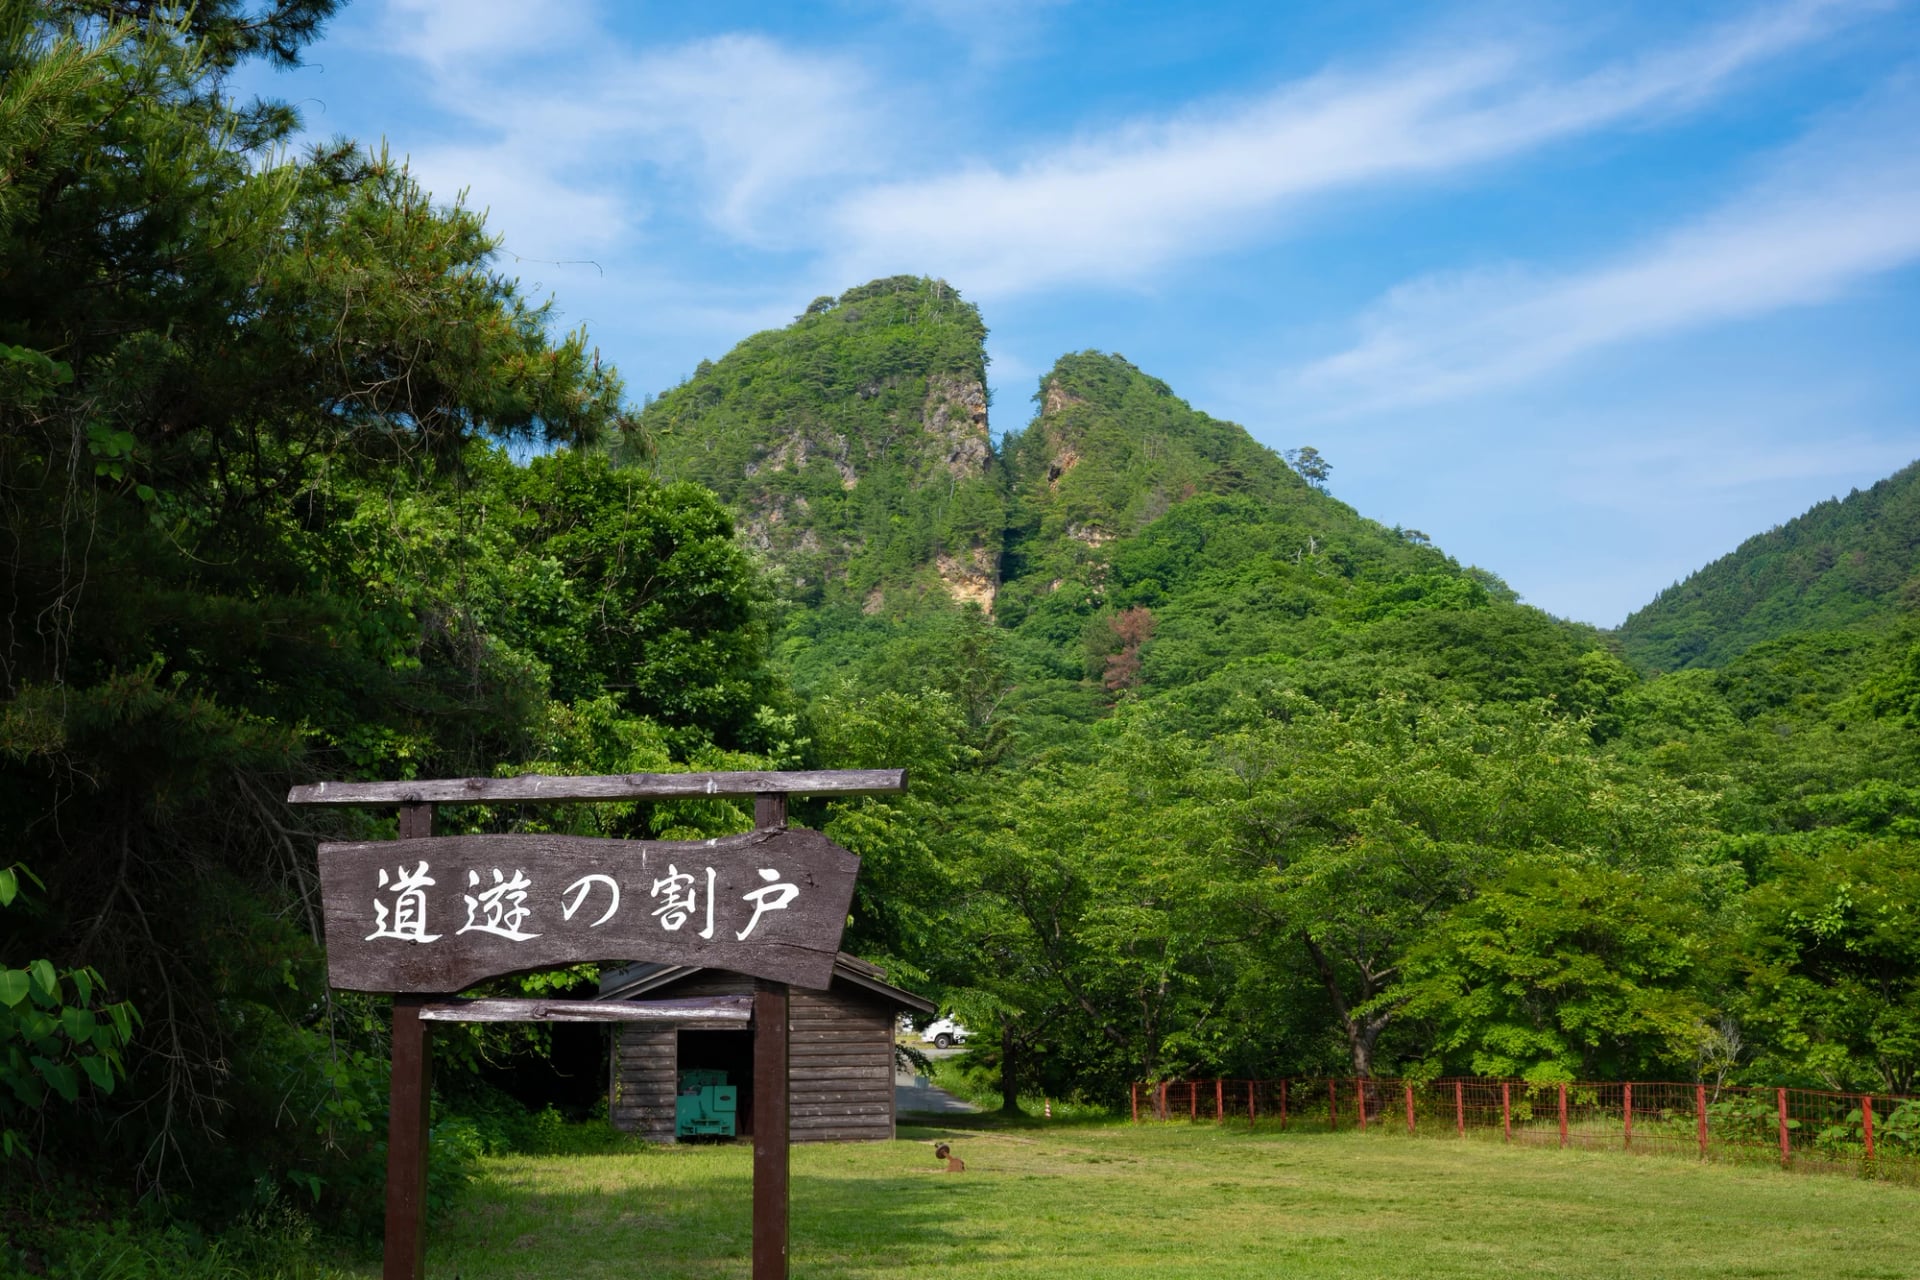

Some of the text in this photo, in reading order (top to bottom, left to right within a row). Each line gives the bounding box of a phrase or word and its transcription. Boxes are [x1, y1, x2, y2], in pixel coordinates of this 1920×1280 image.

[364, 860, 800, 943] 道遊の割戸
